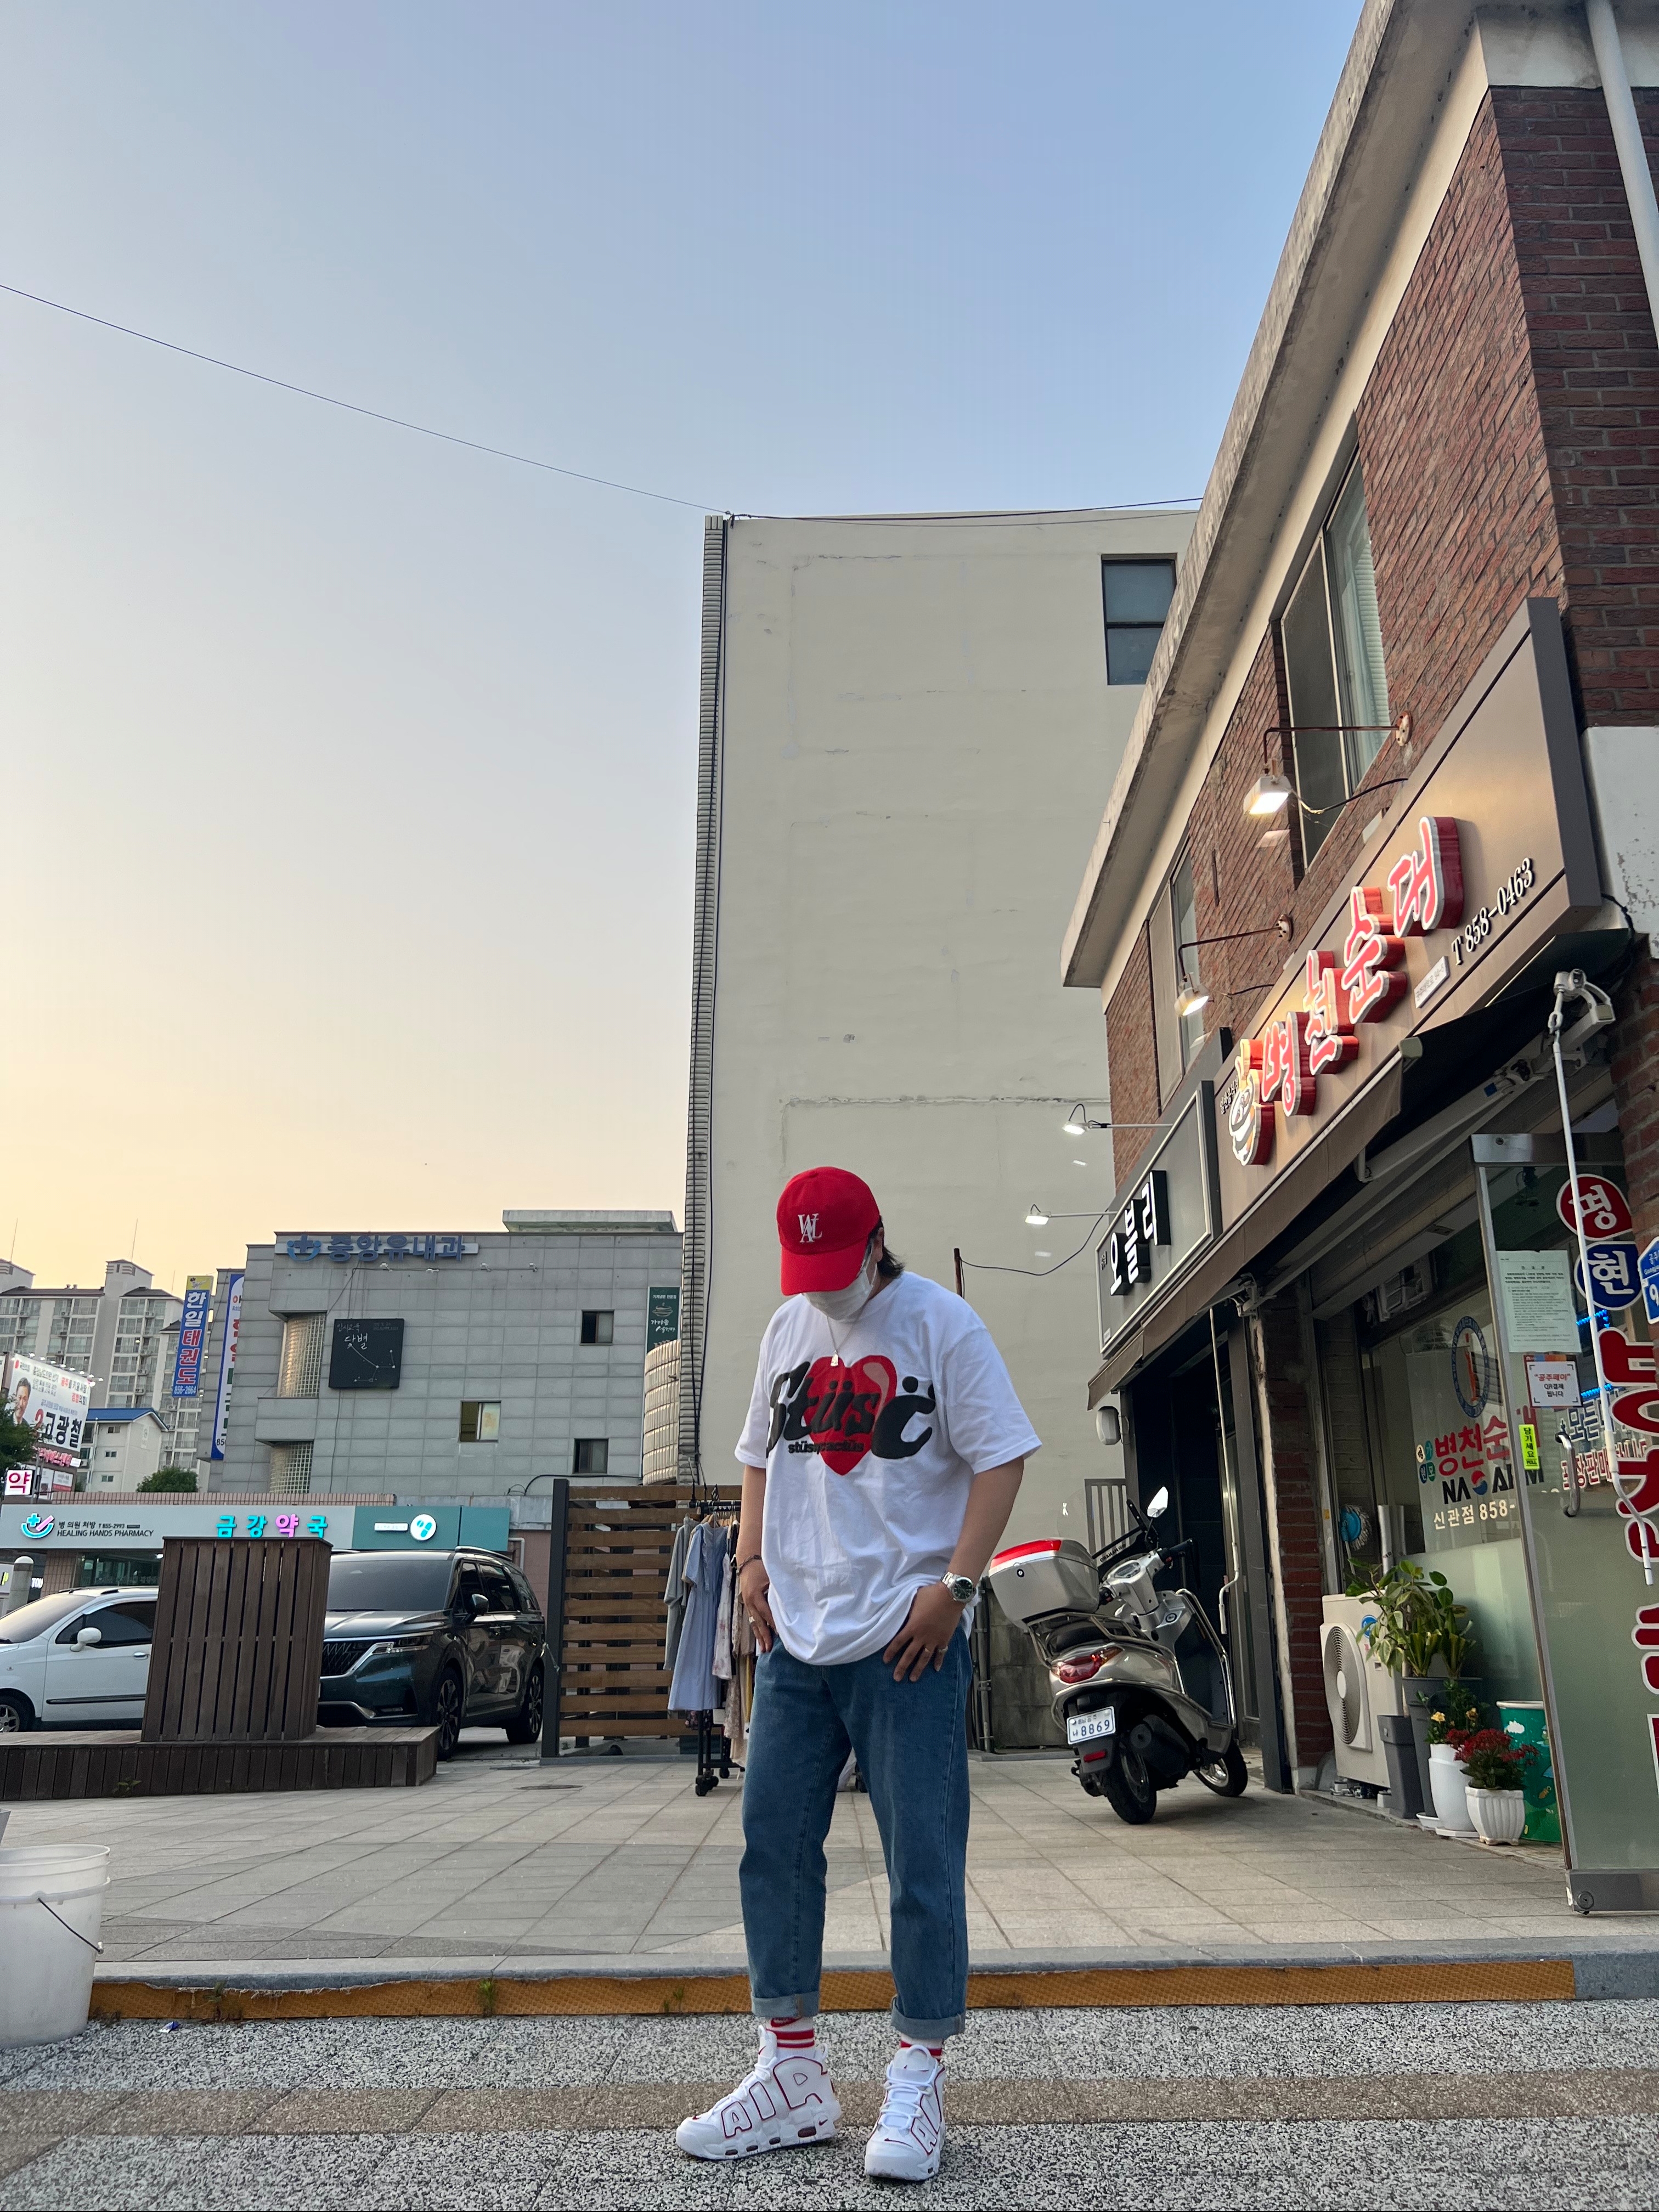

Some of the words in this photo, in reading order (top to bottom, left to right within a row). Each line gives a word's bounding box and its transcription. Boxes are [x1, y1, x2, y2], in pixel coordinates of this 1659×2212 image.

[1451, 936, 1463, 966] T
[1464, 857, 1536, 954] 858-0463
[1261, 816, 1449, 1116] 병천순대
[1110, 1170, 1161, 1295] 오블리
[328, 1234, 465, 1262] 중앙유내과
[1649, 1250, 1659, 1266] 공주
[41, 1411, 82, 1448] 고광철
[1523, 1427, 1535, 1458] 당기세요
[8, 1471, 31, 1494] 약
[217, 1514, 328, 1538] 금강약국
[1434, 1504, 1475, 1530] 신관점
[1081, 1719, 1110, 1736] 8869
